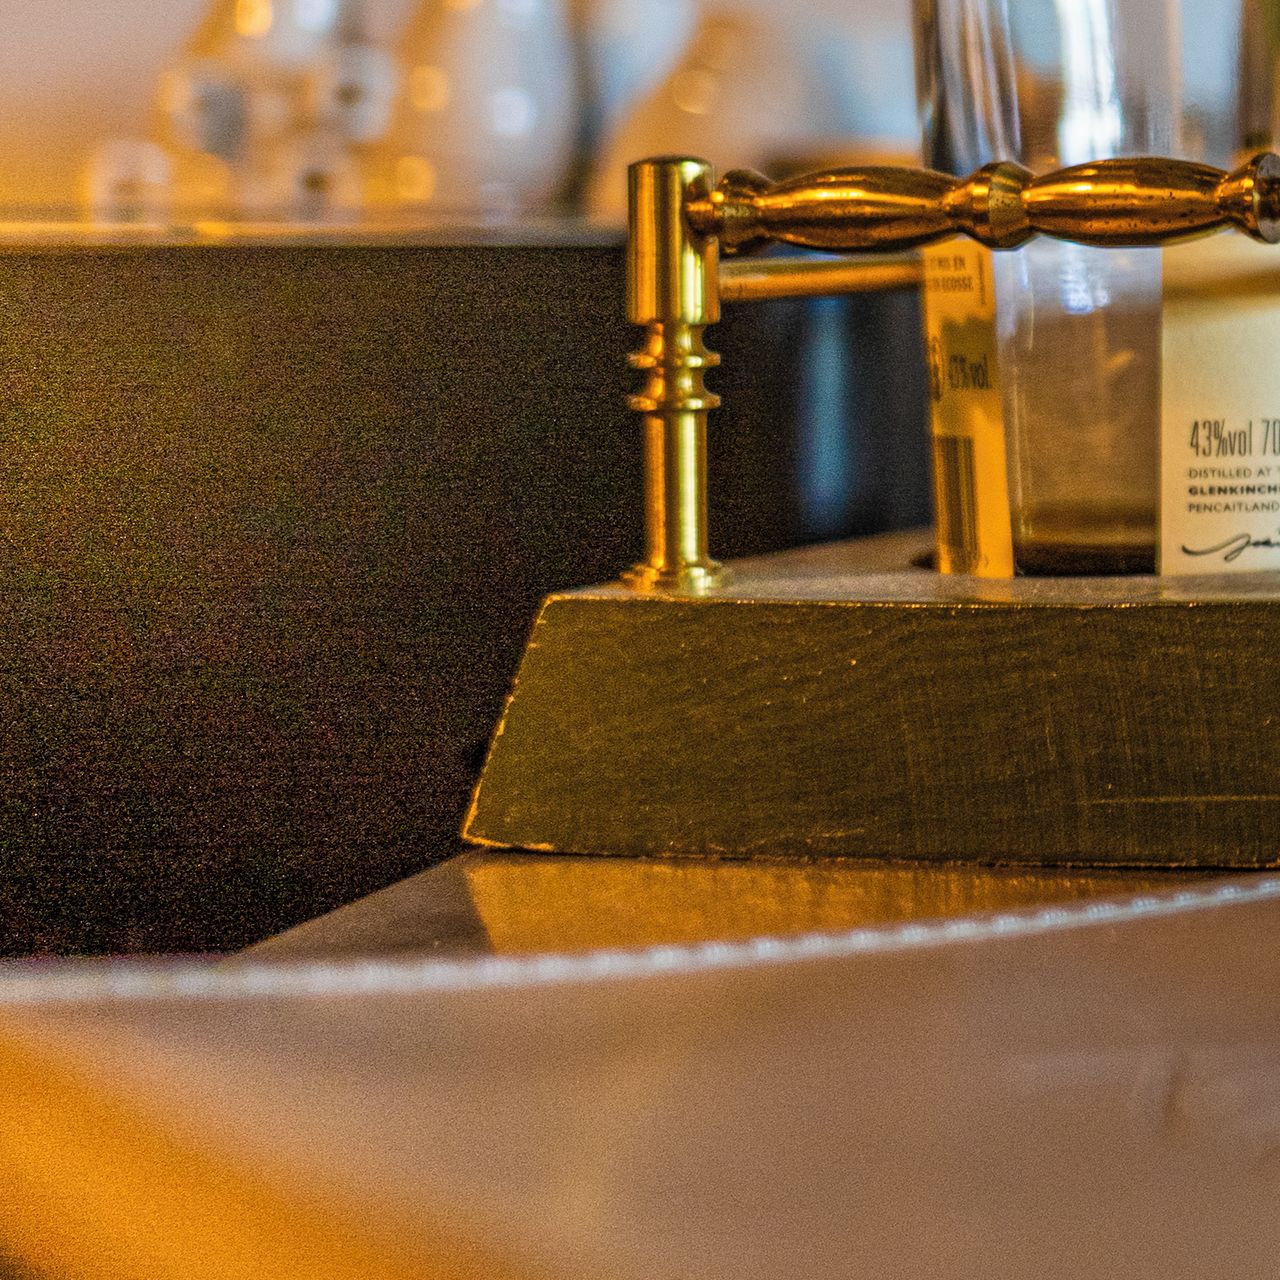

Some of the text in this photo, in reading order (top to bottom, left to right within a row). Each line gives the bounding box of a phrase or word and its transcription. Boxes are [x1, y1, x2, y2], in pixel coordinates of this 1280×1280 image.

[1188, 468, 1250, 479] DISTILLED
[1257, 468, 1270, 478] AT
[1188, 501, 1280, 513] PENCAITLAND
